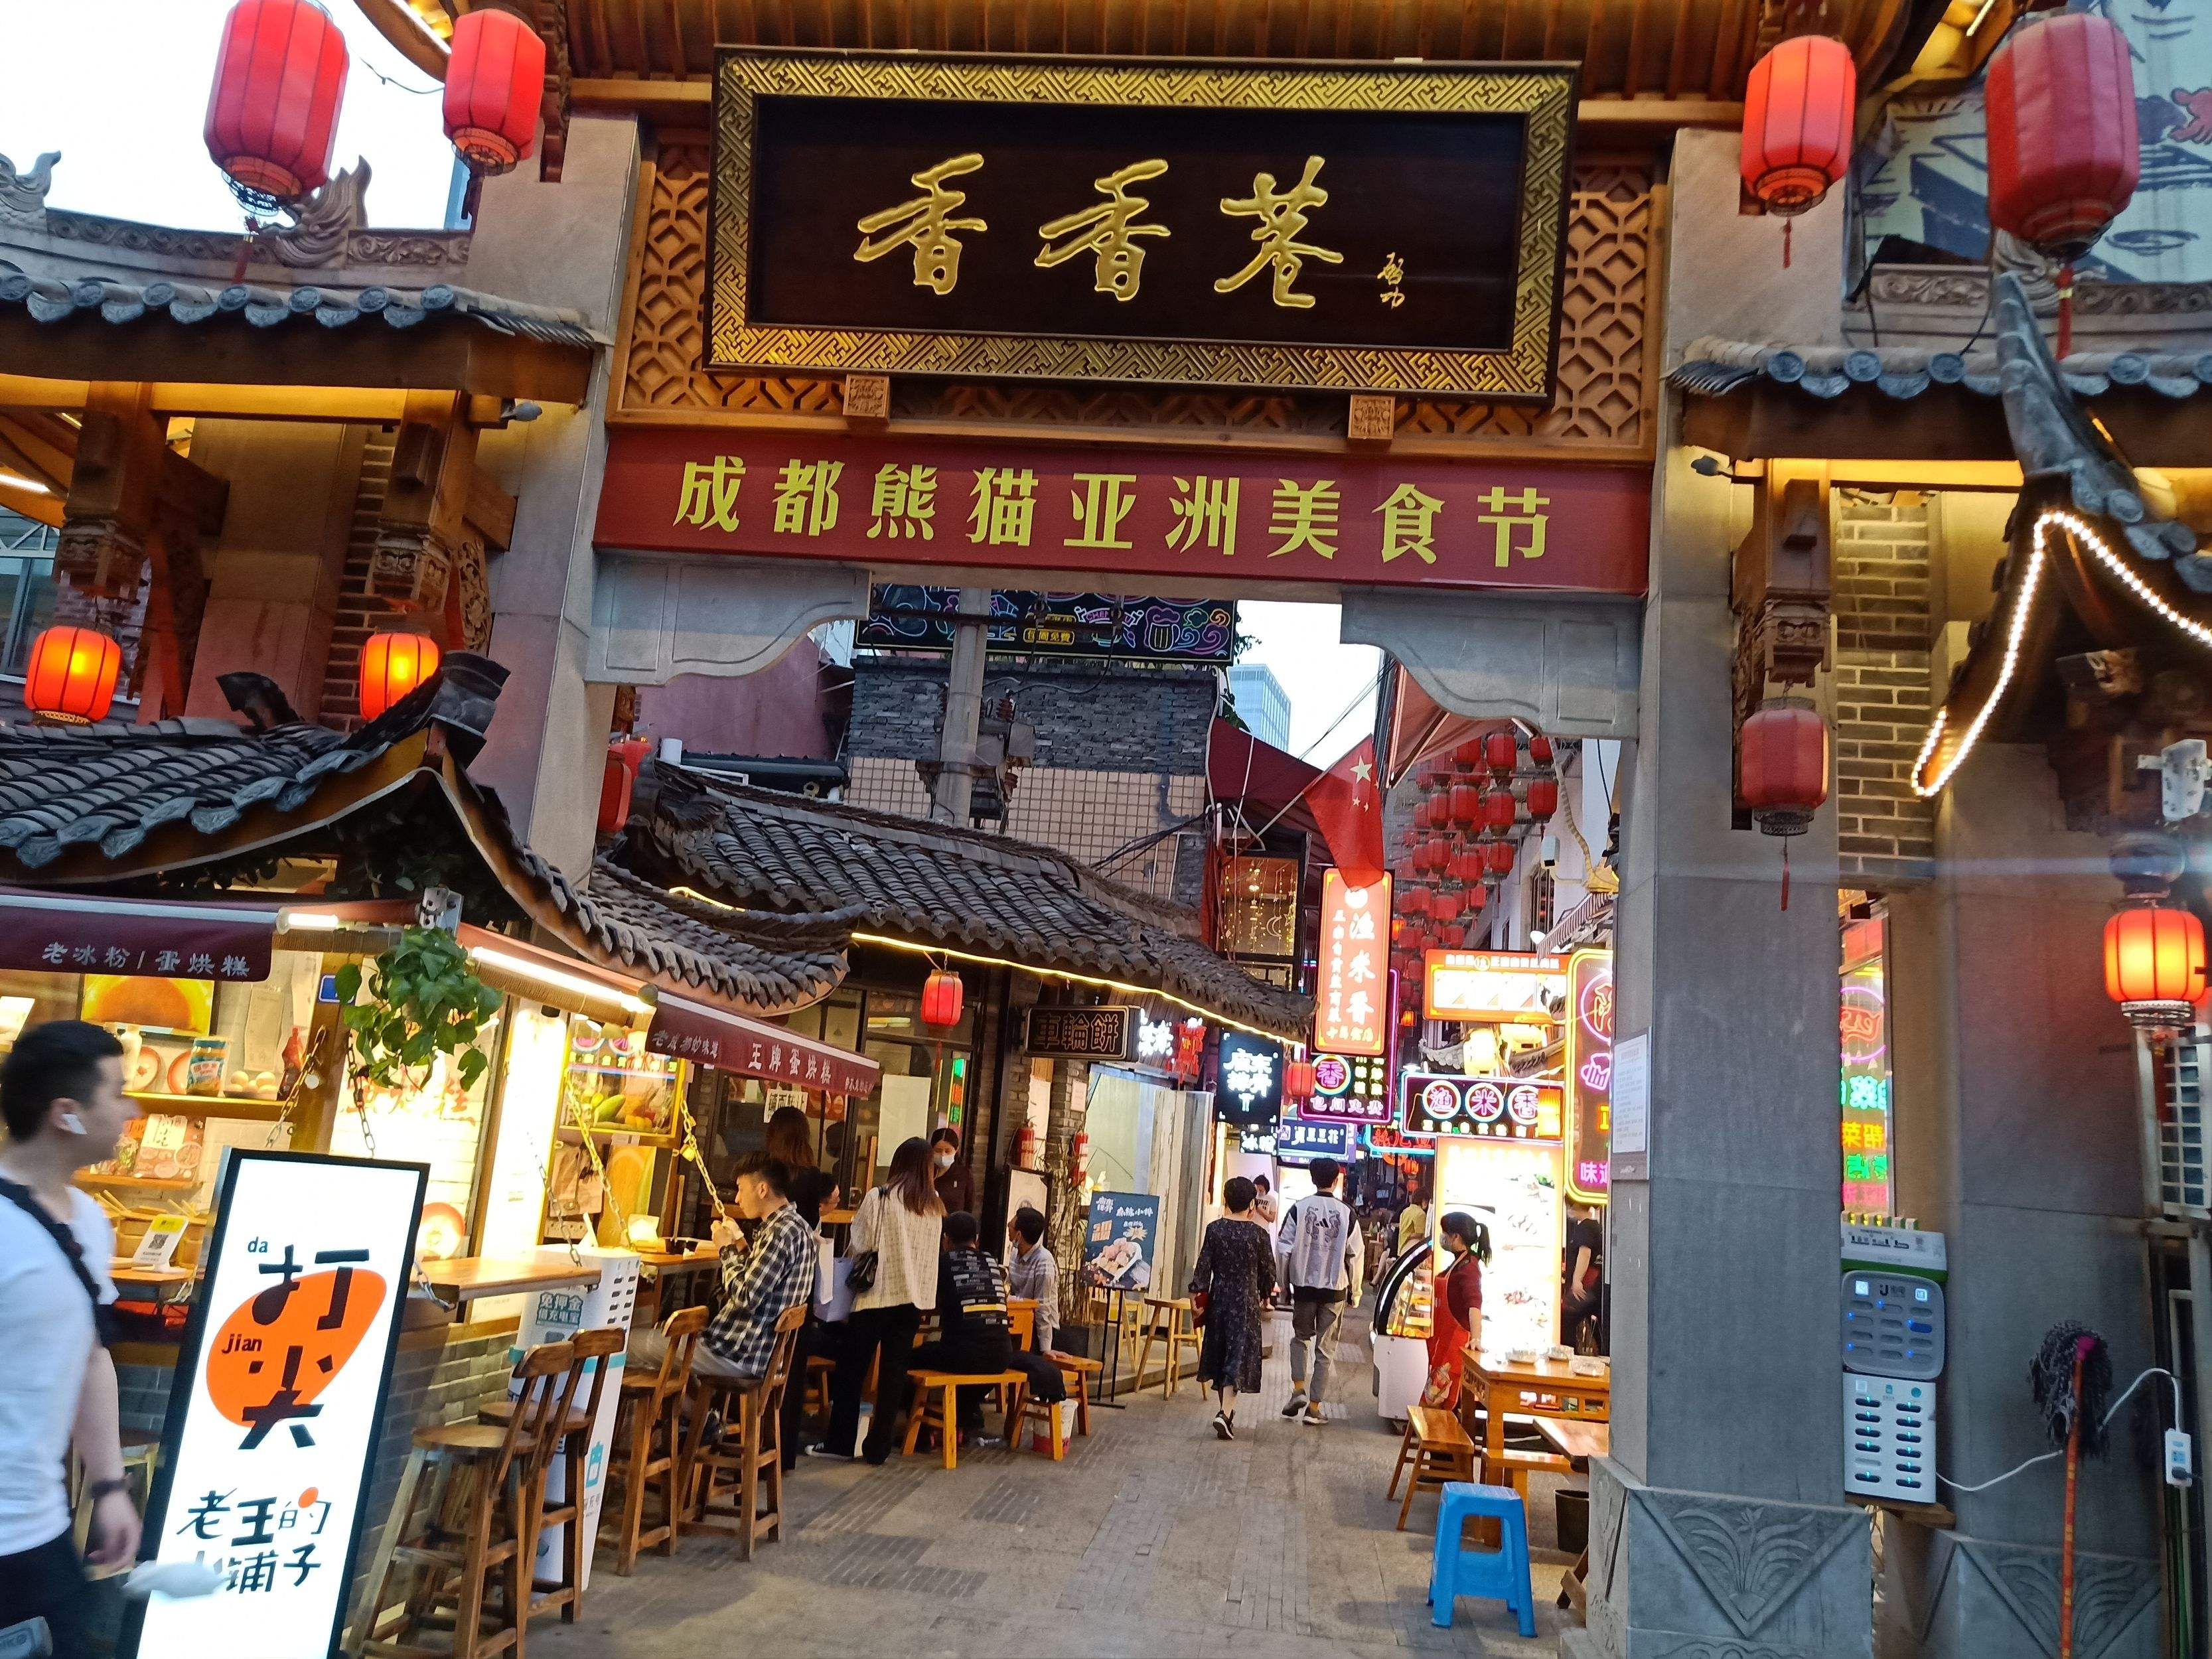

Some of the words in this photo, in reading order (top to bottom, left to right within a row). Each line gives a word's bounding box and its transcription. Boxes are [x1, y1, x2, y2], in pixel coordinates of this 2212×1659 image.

[852, 151, 1345, 309] 香香巷
[675, 455, 1552, 569] 成都熊猫亚洲美食节
[1034, 1013, 1119, 1052] 車輪餅
[748, 1042, 832, 1085] 王牌蛋烘糕
[1316, 1060, 1345, 1088] 香
[247, 1236, 269, 1254] da
[221, 1332, 263, 1354] jian
[177, 1486, 332, 1548] 老王的
